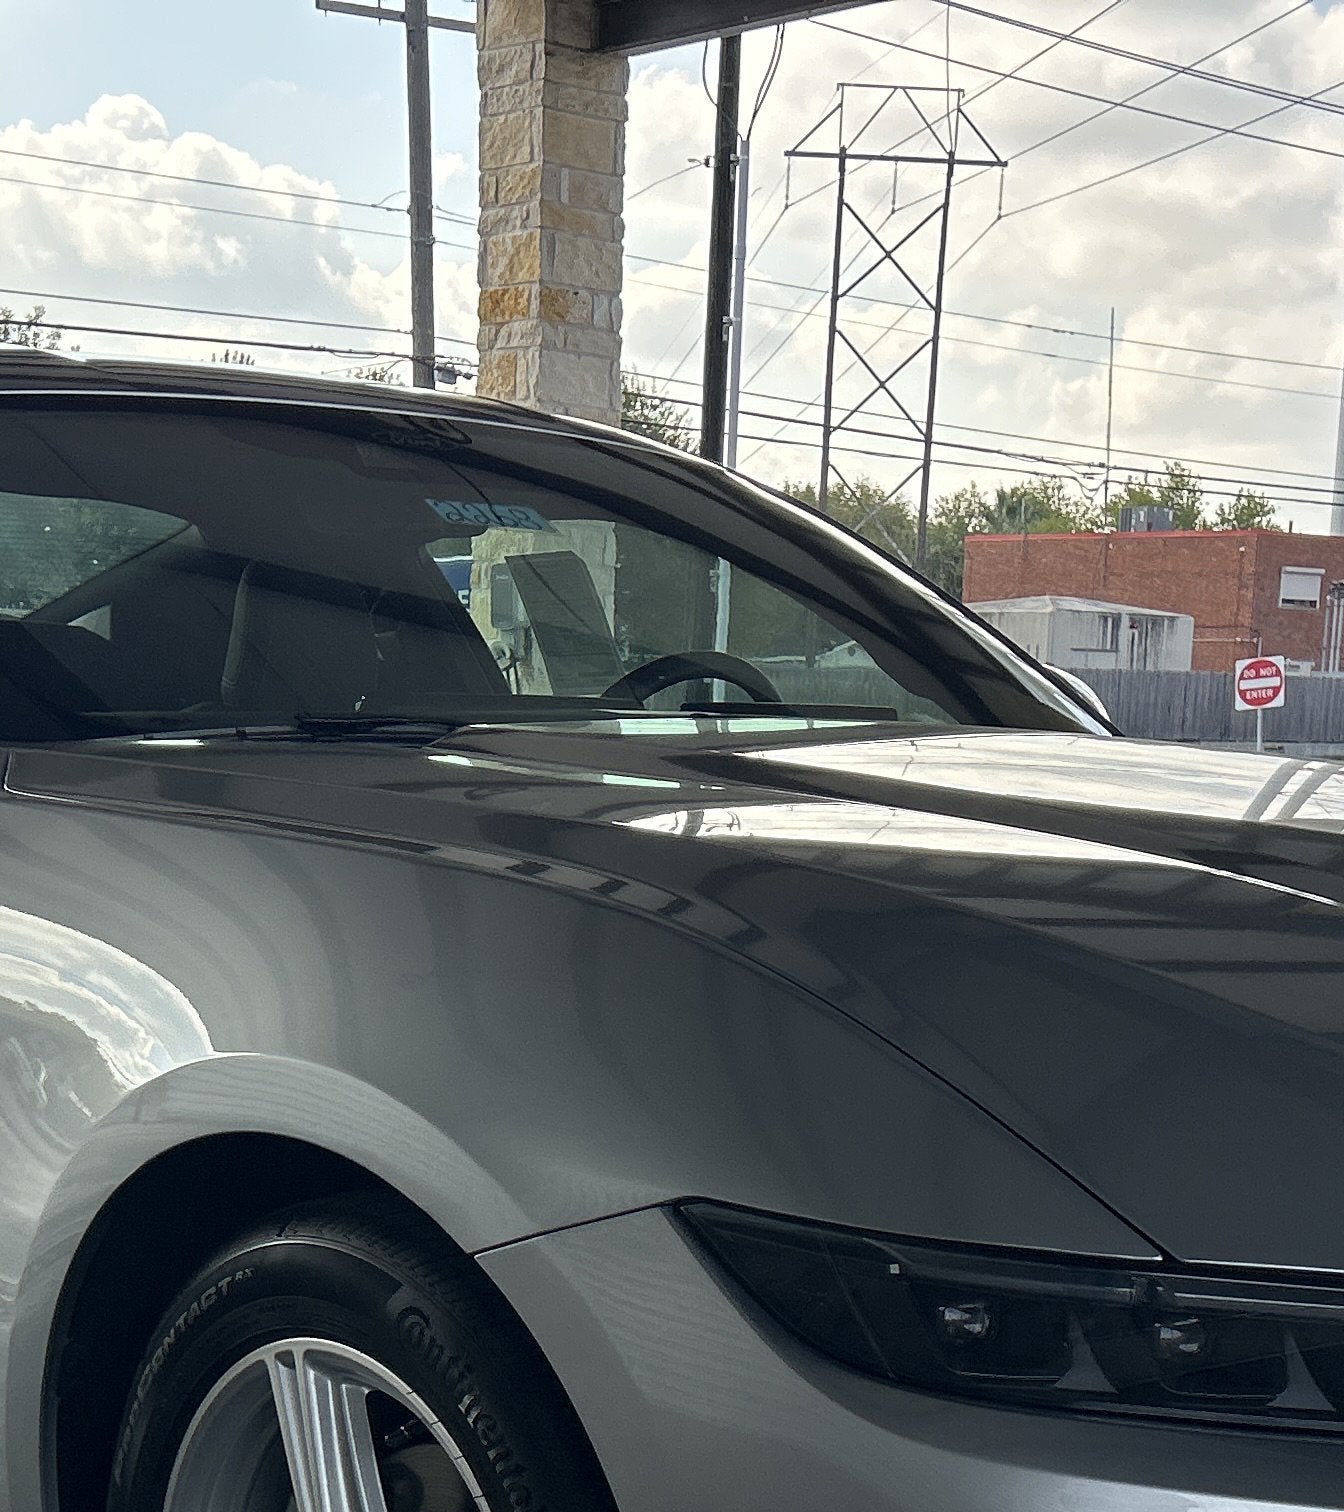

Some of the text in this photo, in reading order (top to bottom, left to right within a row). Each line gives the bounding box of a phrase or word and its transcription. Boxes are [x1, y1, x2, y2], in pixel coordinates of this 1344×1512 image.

[1243, 666, 1278, 679] DO NOT
[1245, 688, 1274, 700] ENTER
